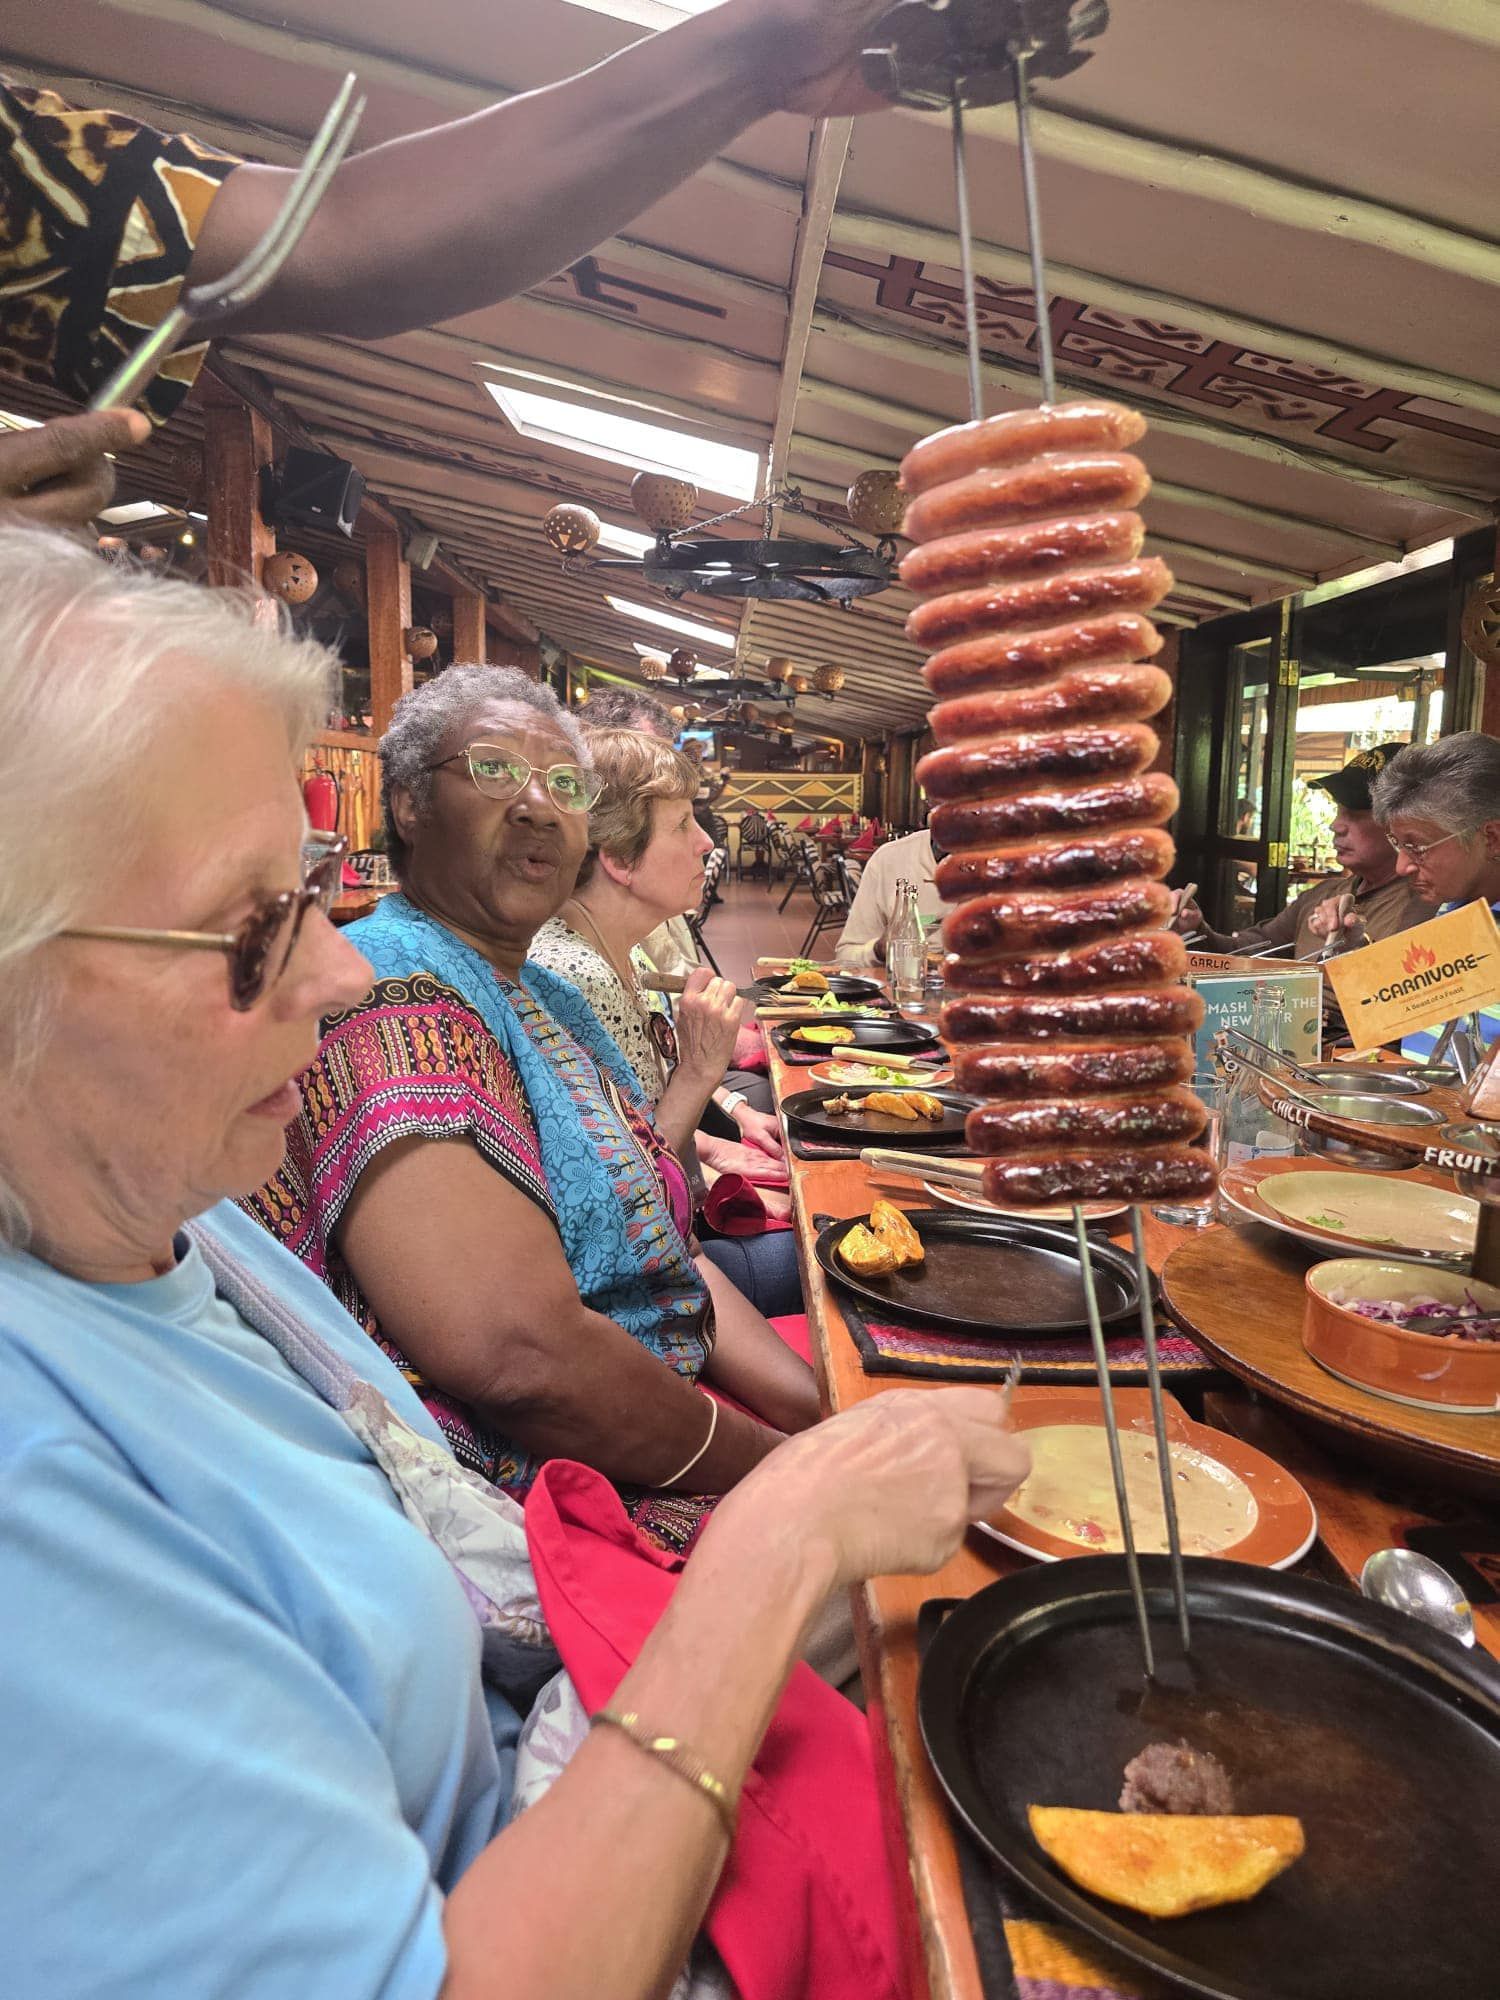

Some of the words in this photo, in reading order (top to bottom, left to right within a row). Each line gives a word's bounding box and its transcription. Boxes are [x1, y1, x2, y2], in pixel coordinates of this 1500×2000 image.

[1190, 957, 1231, 970] GARLIC
[1378, 953, 1478, 1003] CARNIVORE
[1207, 1001, 1248, 1015] MASH
[1291, 997, 1318, 1008] THE
[1220, 1014, 1252, 1027] NEW
[1424, 1146, 1498, 1175] FRUIT
